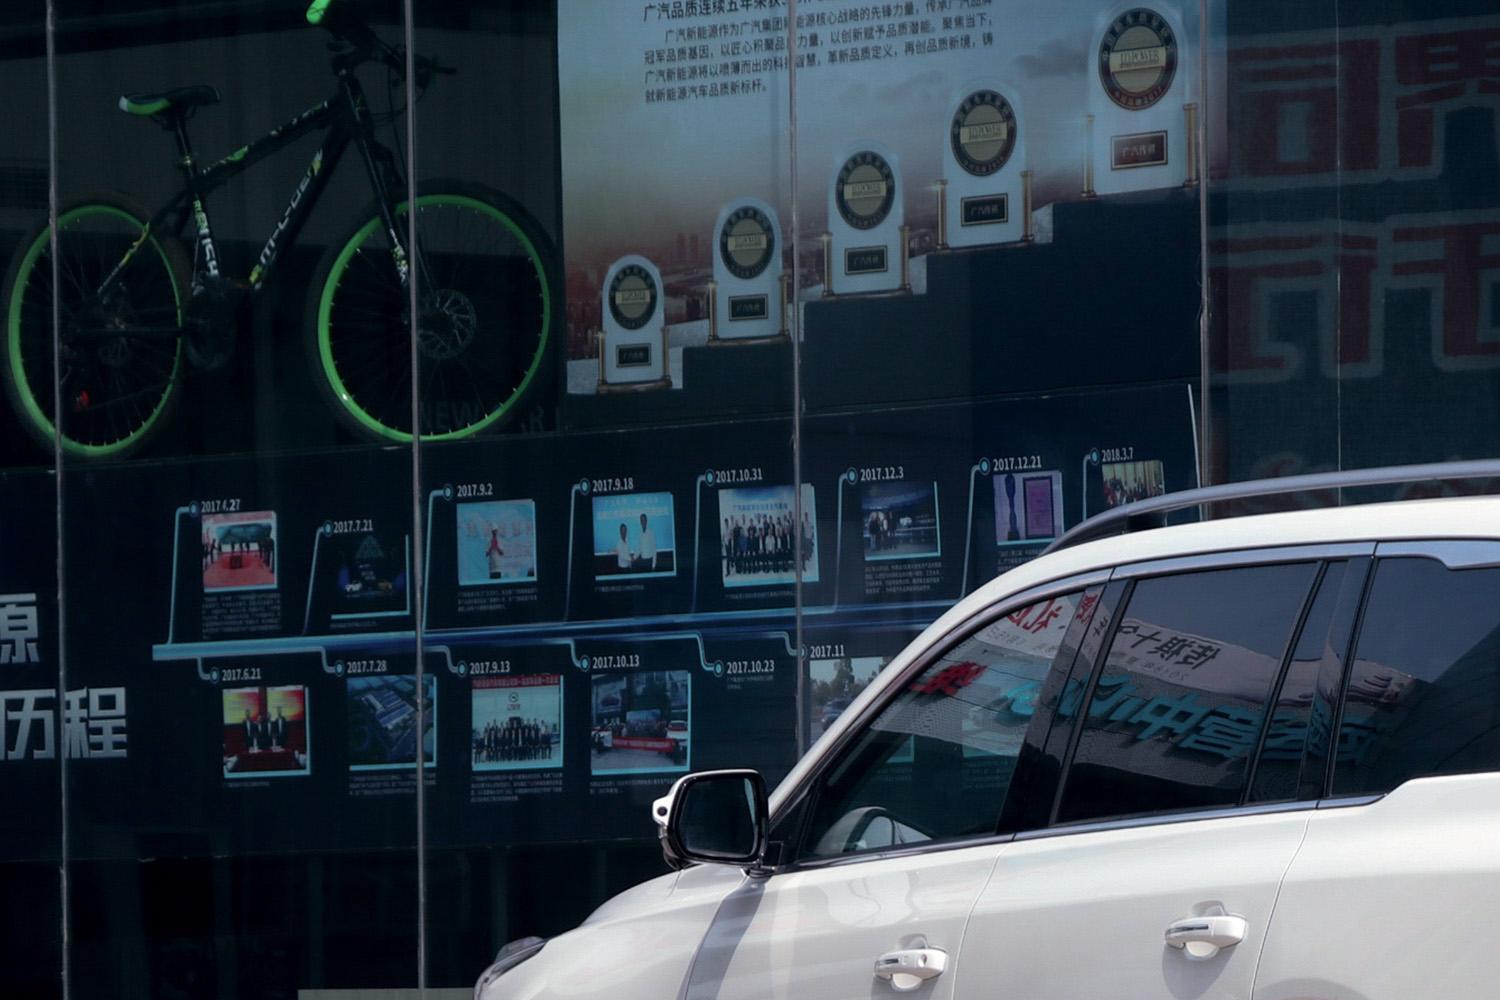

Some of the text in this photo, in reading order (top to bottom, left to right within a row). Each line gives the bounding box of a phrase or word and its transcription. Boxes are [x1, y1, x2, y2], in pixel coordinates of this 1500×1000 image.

[1101, 447, 1134, 462] 2018.3.7
[993, 456, 1042, 471] 2017.12.21
[716, 466, 763, 483] 2017.10.31
[860, 467, 904, 481] 2017.12.3
[457, 483, 493, 497] 2017.9.2
[592, 477, 634, 492] 2017.9.18
[334, 520, 373, 533] 2017.7.21
[810, 644, 845, 658] 2017.11
[346, 660, 388, 673] 2017.7.28
[469, 661, 511, 674] 2017.9.13
[592, 654, 640, 669] 2017.10.13
[726, 660, 775, 674] 2017.10.23
[222, 668, 262, 681] 2017.6.21
